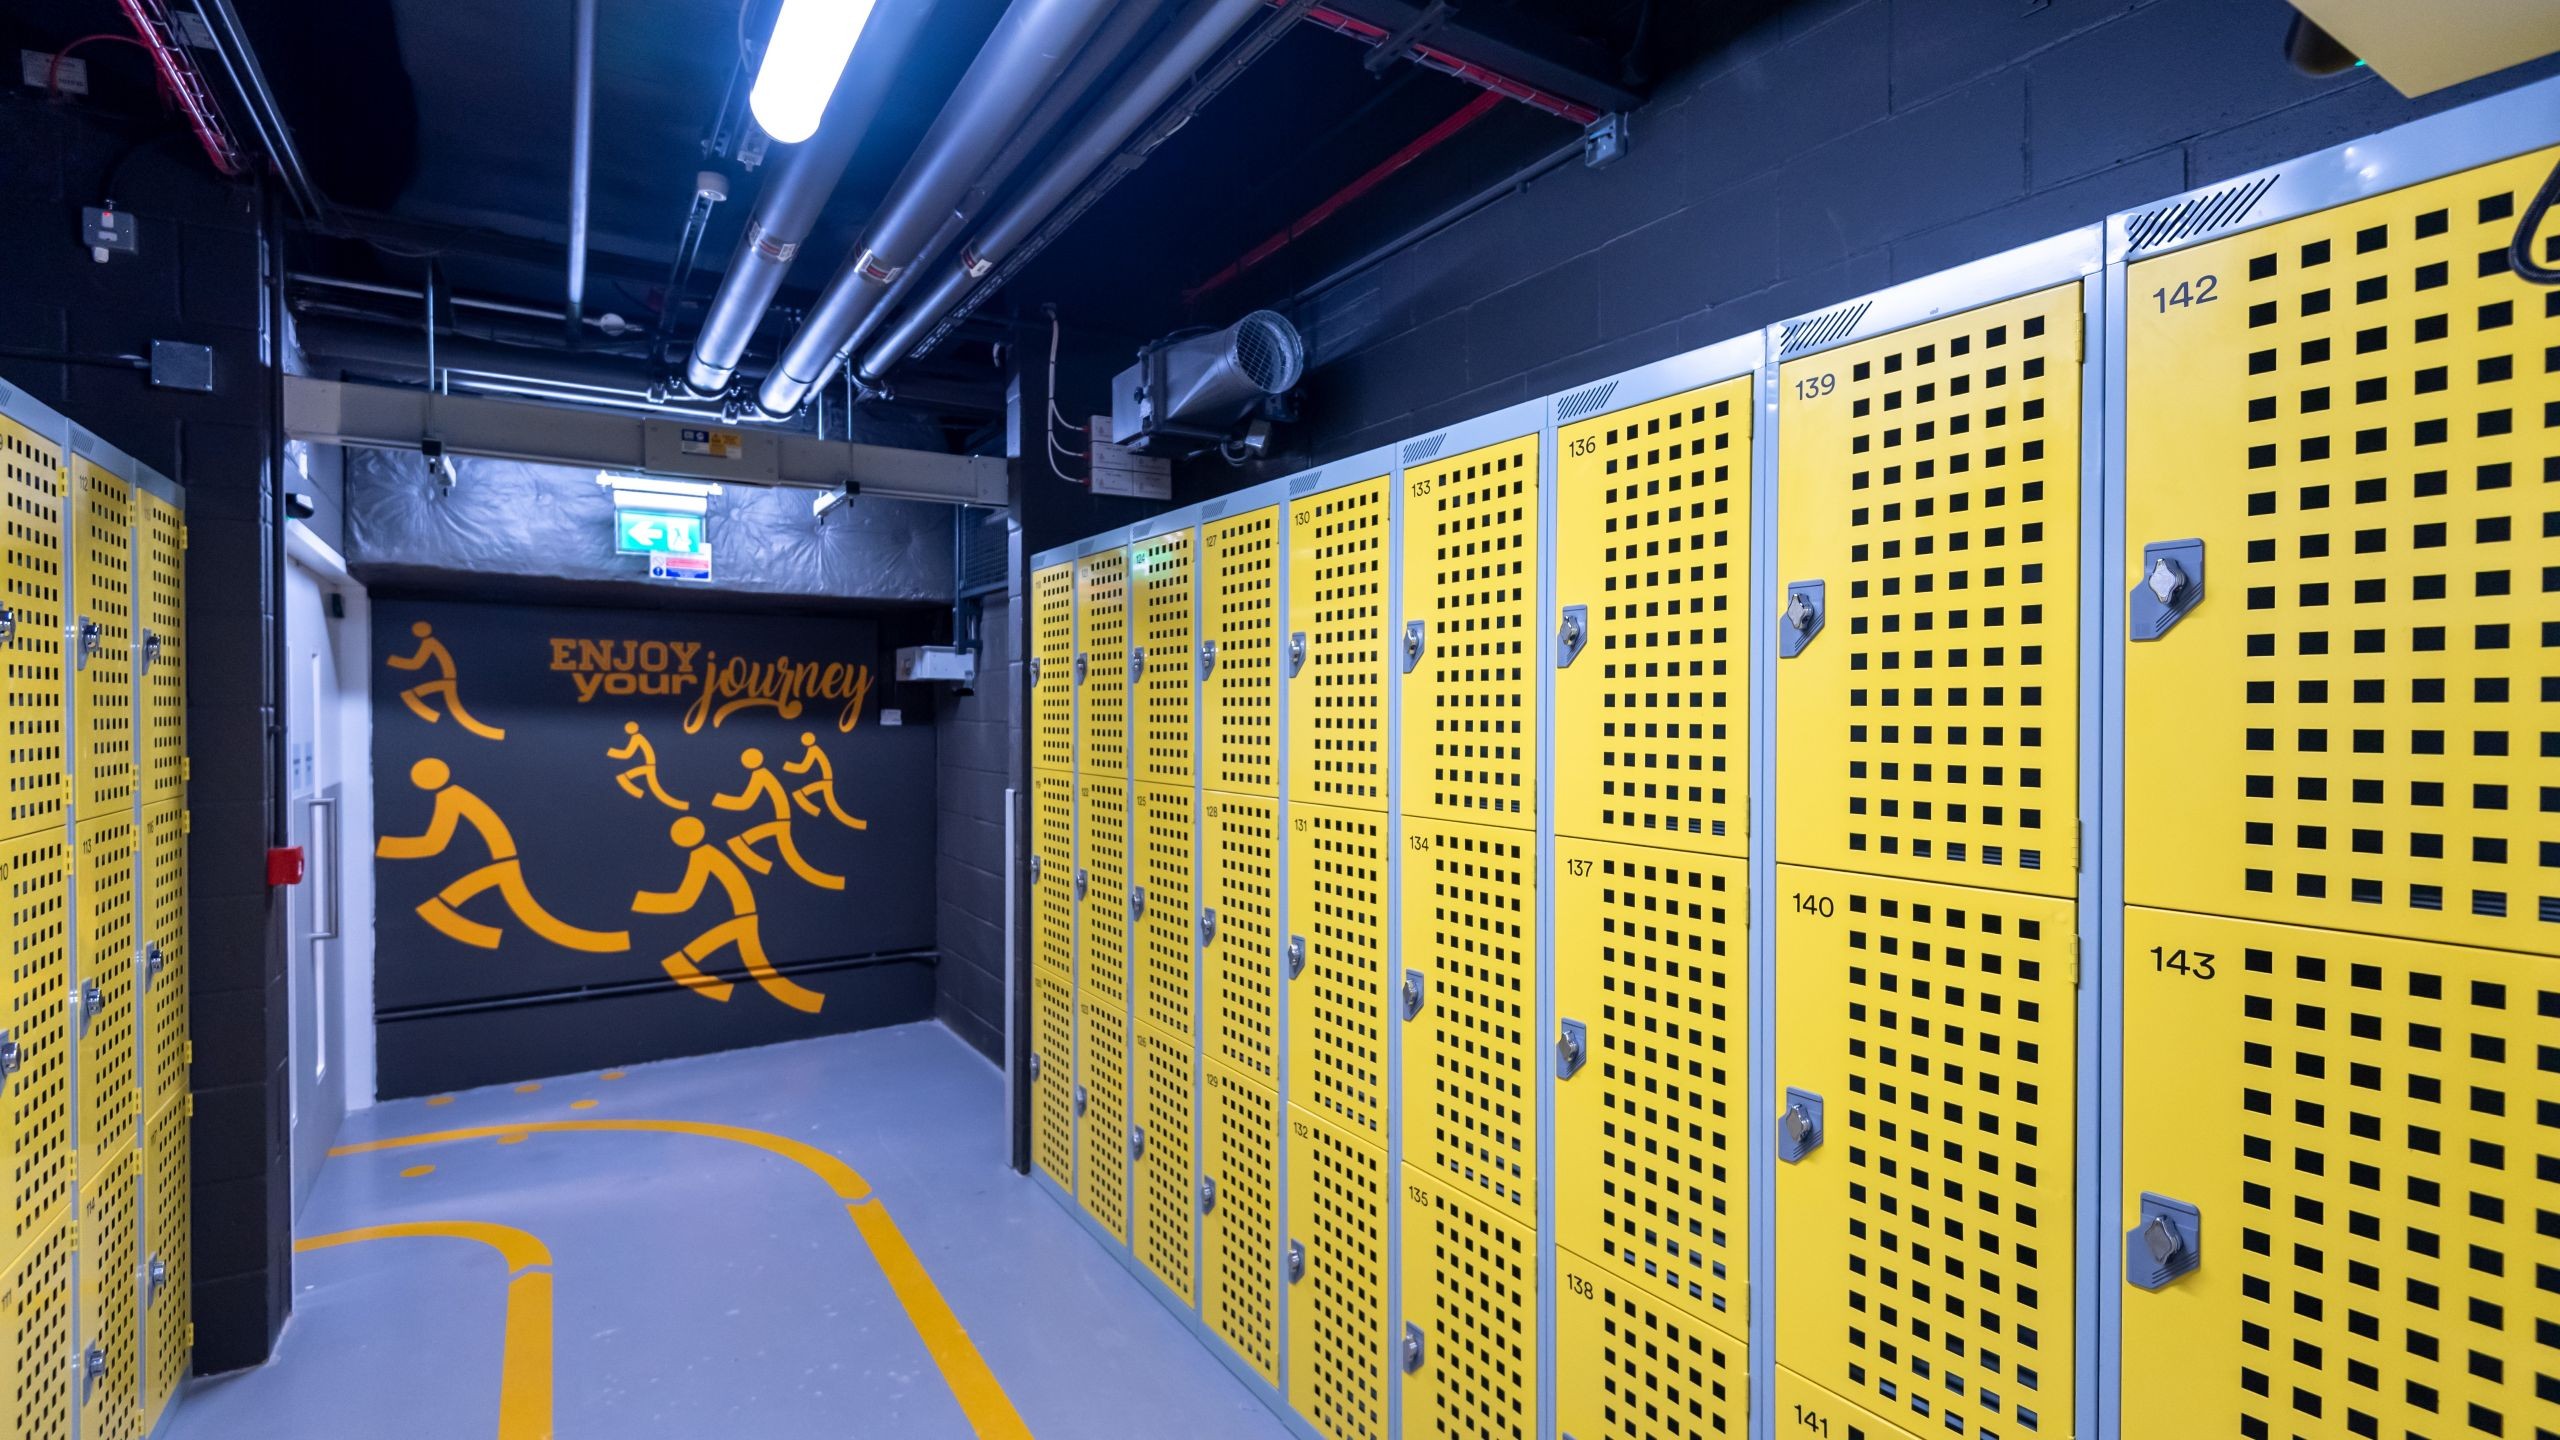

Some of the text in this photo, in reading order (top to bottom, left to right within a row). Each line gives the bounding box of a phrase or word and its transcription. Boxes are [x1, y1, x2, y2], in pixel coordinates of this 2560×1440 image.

[2153, 274, 2218, 313] 142
[1795, 373, 1836, 401] 139
[1568, 436, 1596, 458] 136
[80, 475, 89, 491] 112
[1412, 479, 1430, 498] 133
[1294, 511, 1310, 526] 130
[1206, 535, 1217, 547] 127
[550, 638, 701, 672] ENJOY
[572, 651, 874, 734] your journey
[1206, 806, 1218, 818] 128
[1294, 819, 1307, 832] 131
[83, 838, 92, 854] 113
[1410, 836, 1429, 852] 134
[0, 862, 8, 880] 10
[1567, 859, 1593, 877] 137
[1793, 893, 1834, 918] 140
[2150, 946, 2215, 980] 143
[1206, 1073, 1218, 1088] 129
[1293, 1122, 1308, 1139] 132
[1409, 1186, 1428, 1207] 135
[1567, 1273, 1594, 1300] 138
[1795, 1404, 1829, 1439] 141
